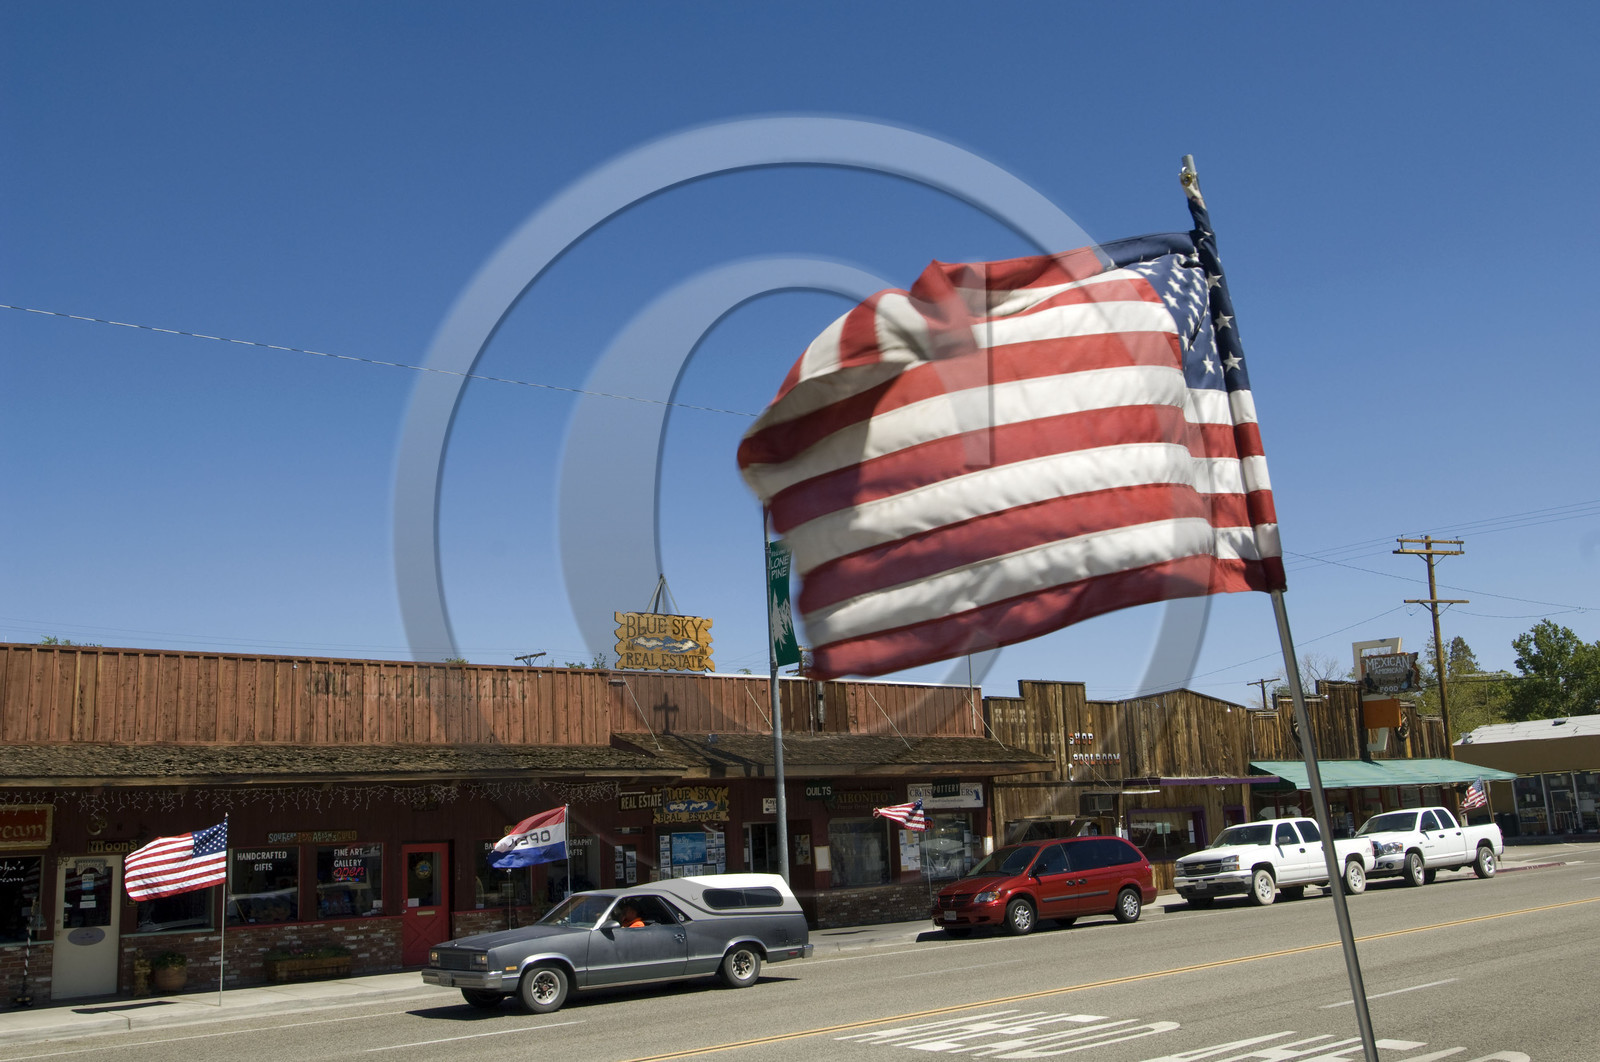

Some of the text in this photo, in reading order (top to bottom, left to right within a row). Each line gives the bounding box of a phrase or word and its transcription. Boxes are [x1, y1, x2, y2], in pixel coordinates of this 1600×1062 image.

[770, 555, 790, 570] LONE
[771, 566, 787, 581] PINE
[626, 615, 703, 641] BLUE SKY
[626, 652, 705, 669] REAL ESTATE
[1366, 656, 1410, 673] MEXICAN
[1069, 732, 1094, 746] SHOP
[698, 788, 721, 801] SKY
[806, 786, 832, 797] QUILTS
[909, 788, 933, 798] CRUIS
[933, 784, 960, 794] POTTERY
[621, 793, 663, 810] REAL ESTATE
[660, 812, 721, 822] REAL ESTATE
[569, 839, 593, 847] GRAPHY
[237, 851, 288, 861] HANDCRAFTED
[334, 848, 364, 857] FINE ART
[254, 863, 273, 872] GIFTS
[334, 859, 363, 868] GALLERY
[833, 1009, 1181, 1059] AHEAD
[1139, 1030, 1532, 1062] AHE
